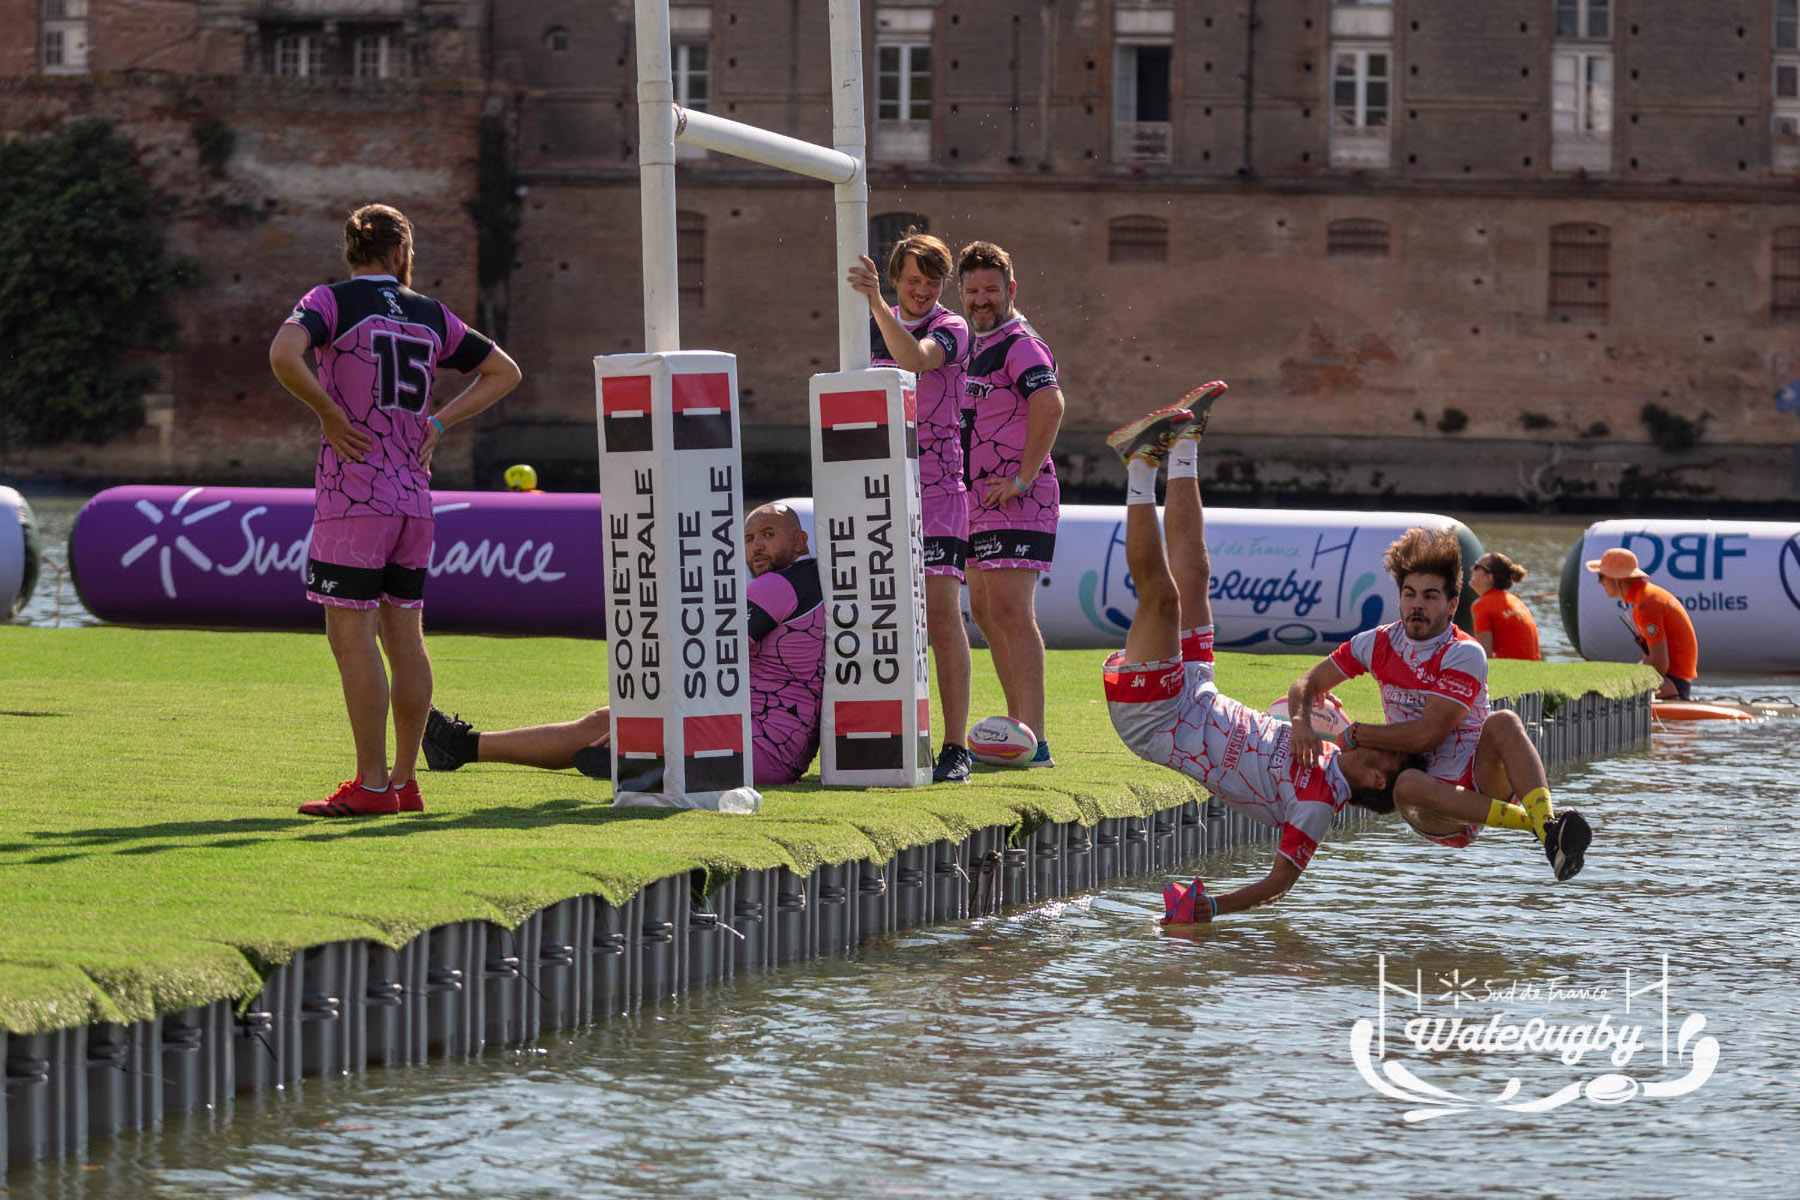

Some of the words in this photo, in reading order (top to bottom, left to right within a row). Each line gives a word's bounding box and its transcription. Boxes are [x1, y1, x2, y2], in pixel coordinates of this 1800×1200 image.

[371, 330, 434, 414] 15
[218, 506, 315, 584] Sud
[428, 502, 567, 583] ance
[610, 513, 635, 700] SOCIETE
[634, 468, 661, 701] GENERALE
[677, 510, 707, 699] SOCIETE
[709, 465, 740, 698] GENERALE
[829, 516, 862, 686] SOCIETE
[864, 474, 900, 685] GENERALE
[1620, 531, 1749, 580] DBF
